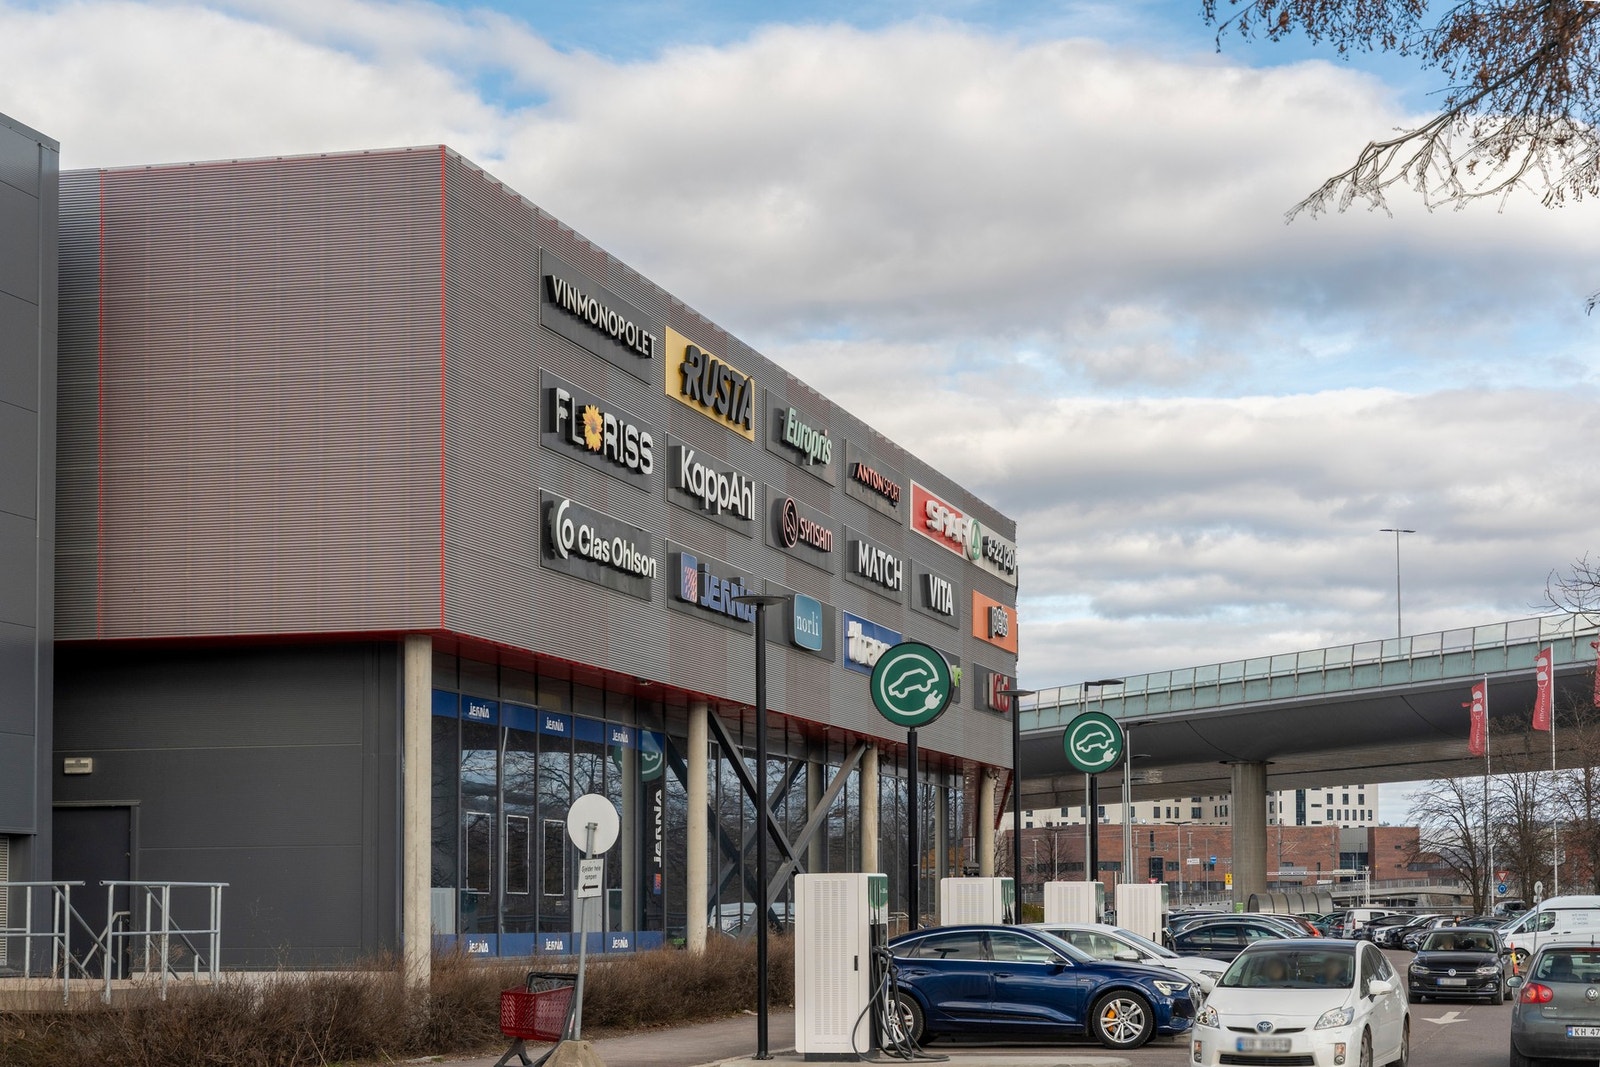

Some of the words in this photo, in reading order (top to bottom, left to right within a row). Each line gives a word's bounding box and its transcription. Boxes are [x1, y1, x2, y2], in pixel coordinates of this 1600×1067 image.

[551, 274, 657, 359] VINMONOPOLET
[681, 345, 753, 431] RUSTA
[787, 407, 832, 466] Europris
[681, 445, 755, 521] KappAhl
[578, 524, 610, 563] Clas
[612, 537, 657, 579] Ohlson
[858, 540, 903, 591] MATCH
[929, 574, 954, 616] VITA
[796, 611, 820, 636] norli
[1574, 1028, 1587, 1036] KH
